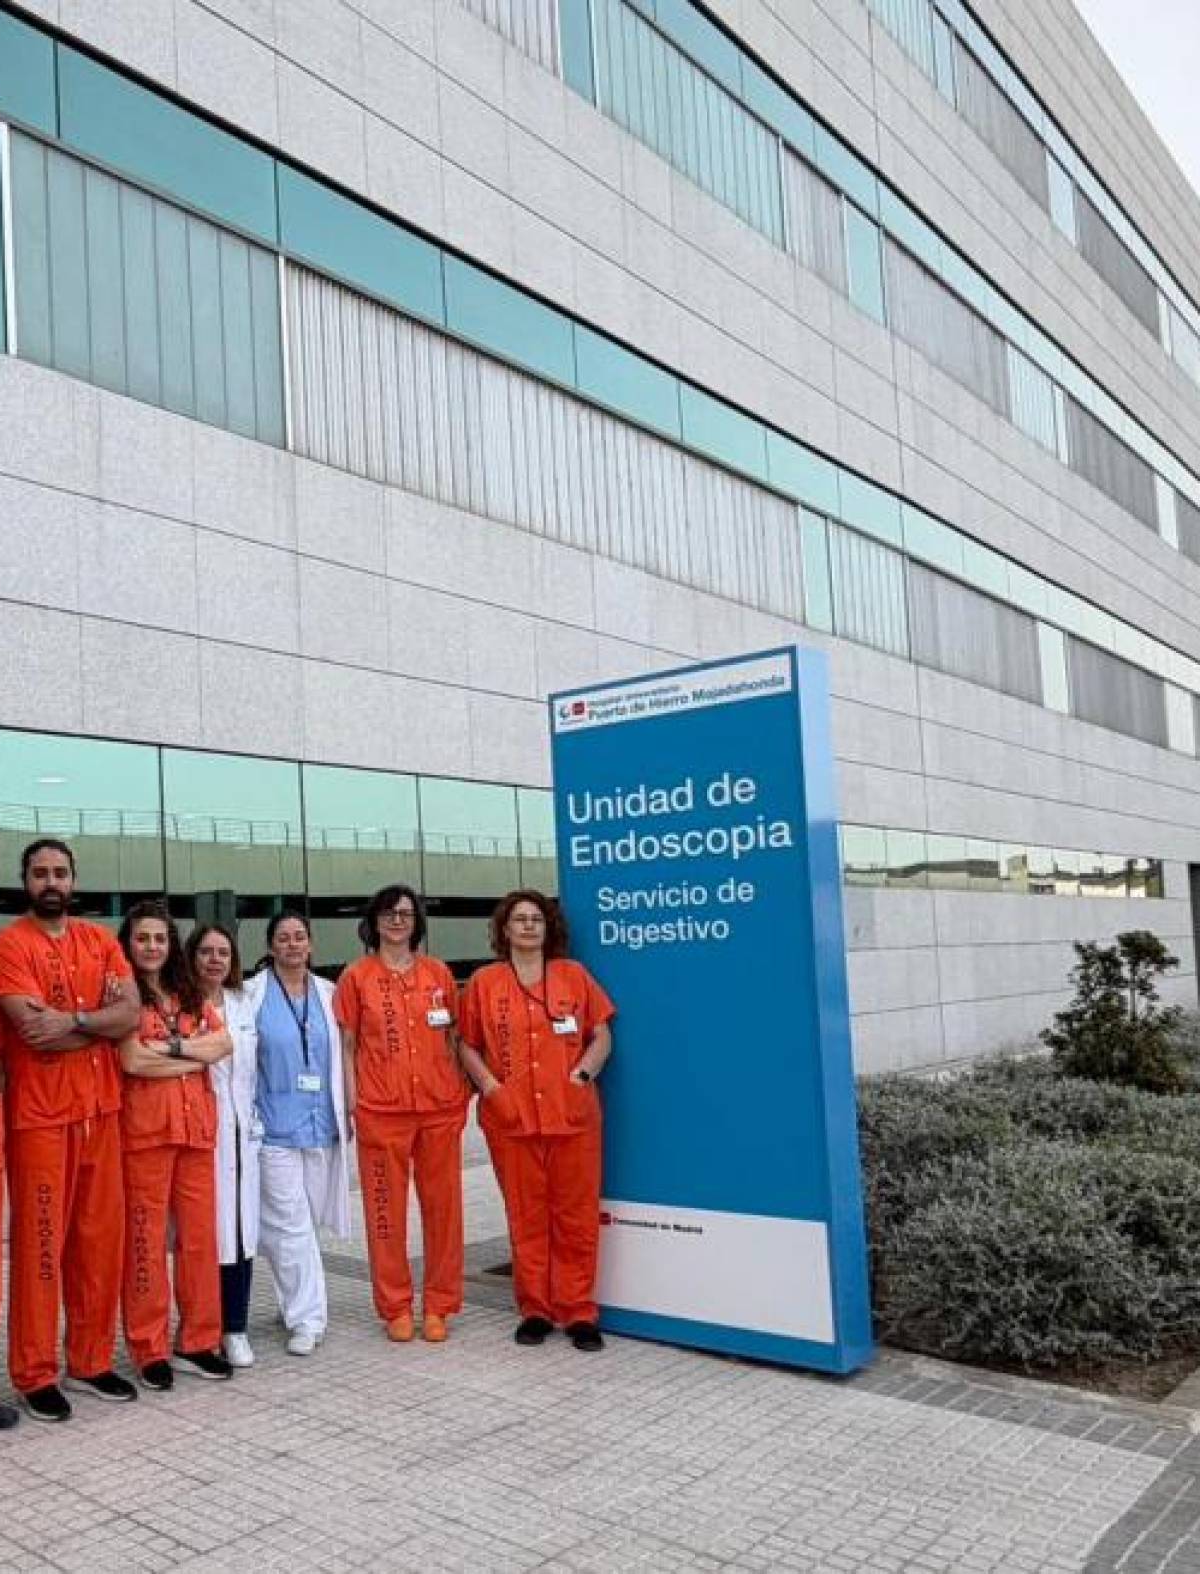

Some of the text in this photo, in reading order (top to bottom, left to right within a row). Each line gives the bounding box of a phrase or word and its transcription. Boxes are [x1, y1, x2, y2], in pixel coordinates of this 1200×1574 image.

[568, 773, 756, 823] Unidad de
[570, 815, 793, 867] Endoscopia
[598, 878, 754, 911] Servicio de
[600, 916, 729, 950] Digestivo
